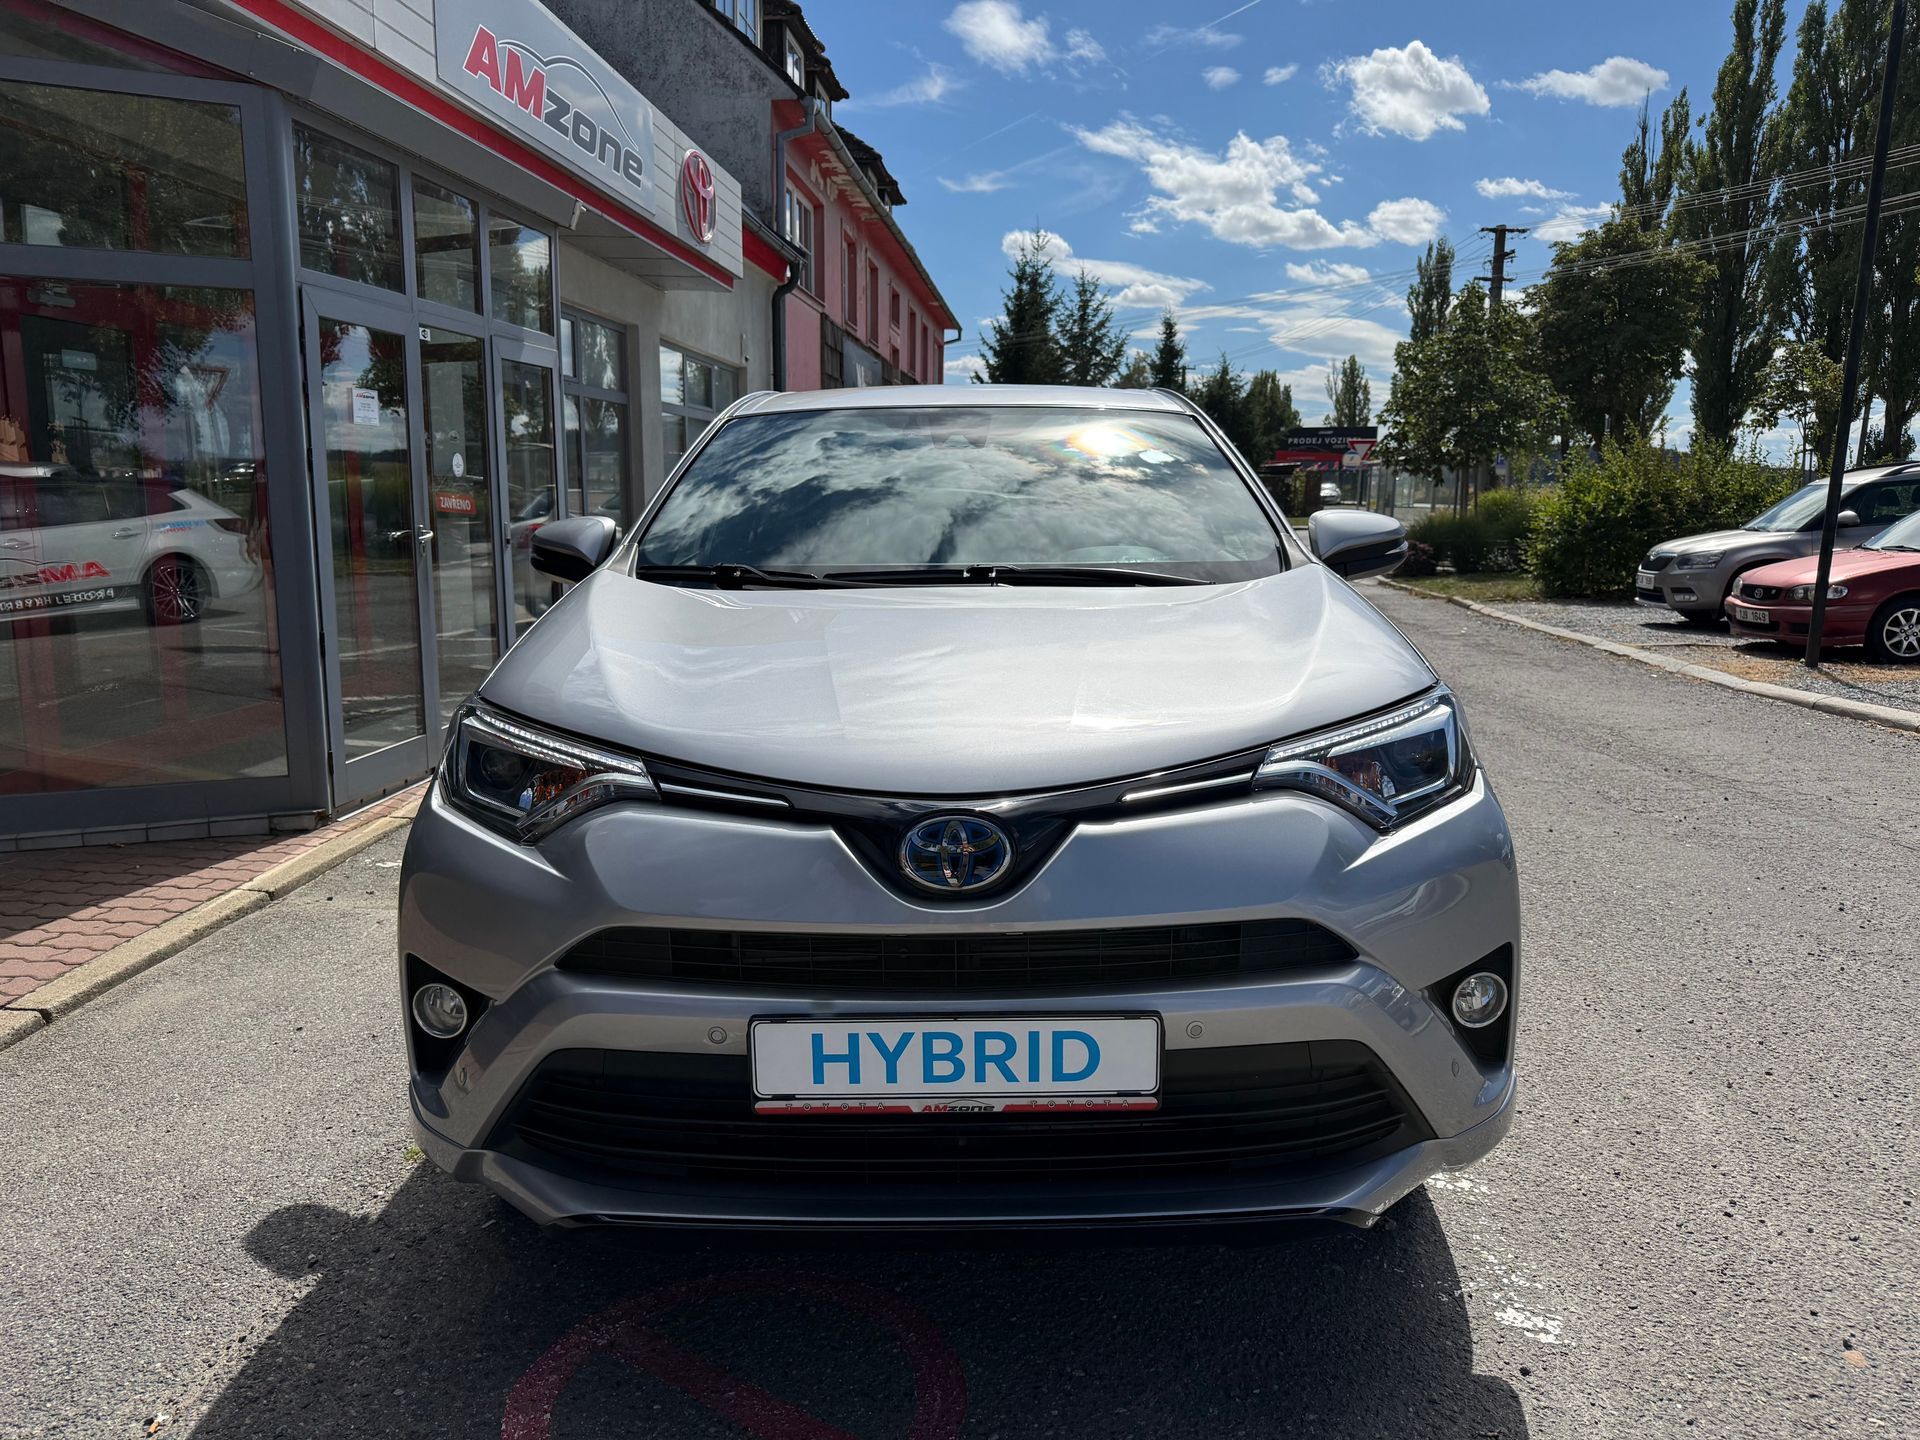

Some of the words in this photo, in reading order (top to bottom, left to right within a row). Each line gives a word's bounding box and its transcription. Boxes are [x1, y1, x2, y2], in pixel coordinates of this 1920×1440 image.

[463, 24, 643, 190] AMzone
[440, 495, 472, 511] ZAVŘENO
[811, 1030, 1101, 1085] HYBRID
[785, 1103, 884, 1111] TOYOTA
[921, 1102, 996, 1112] AMzone
[1031, 1100, 1129, 1108] TOYOTA
